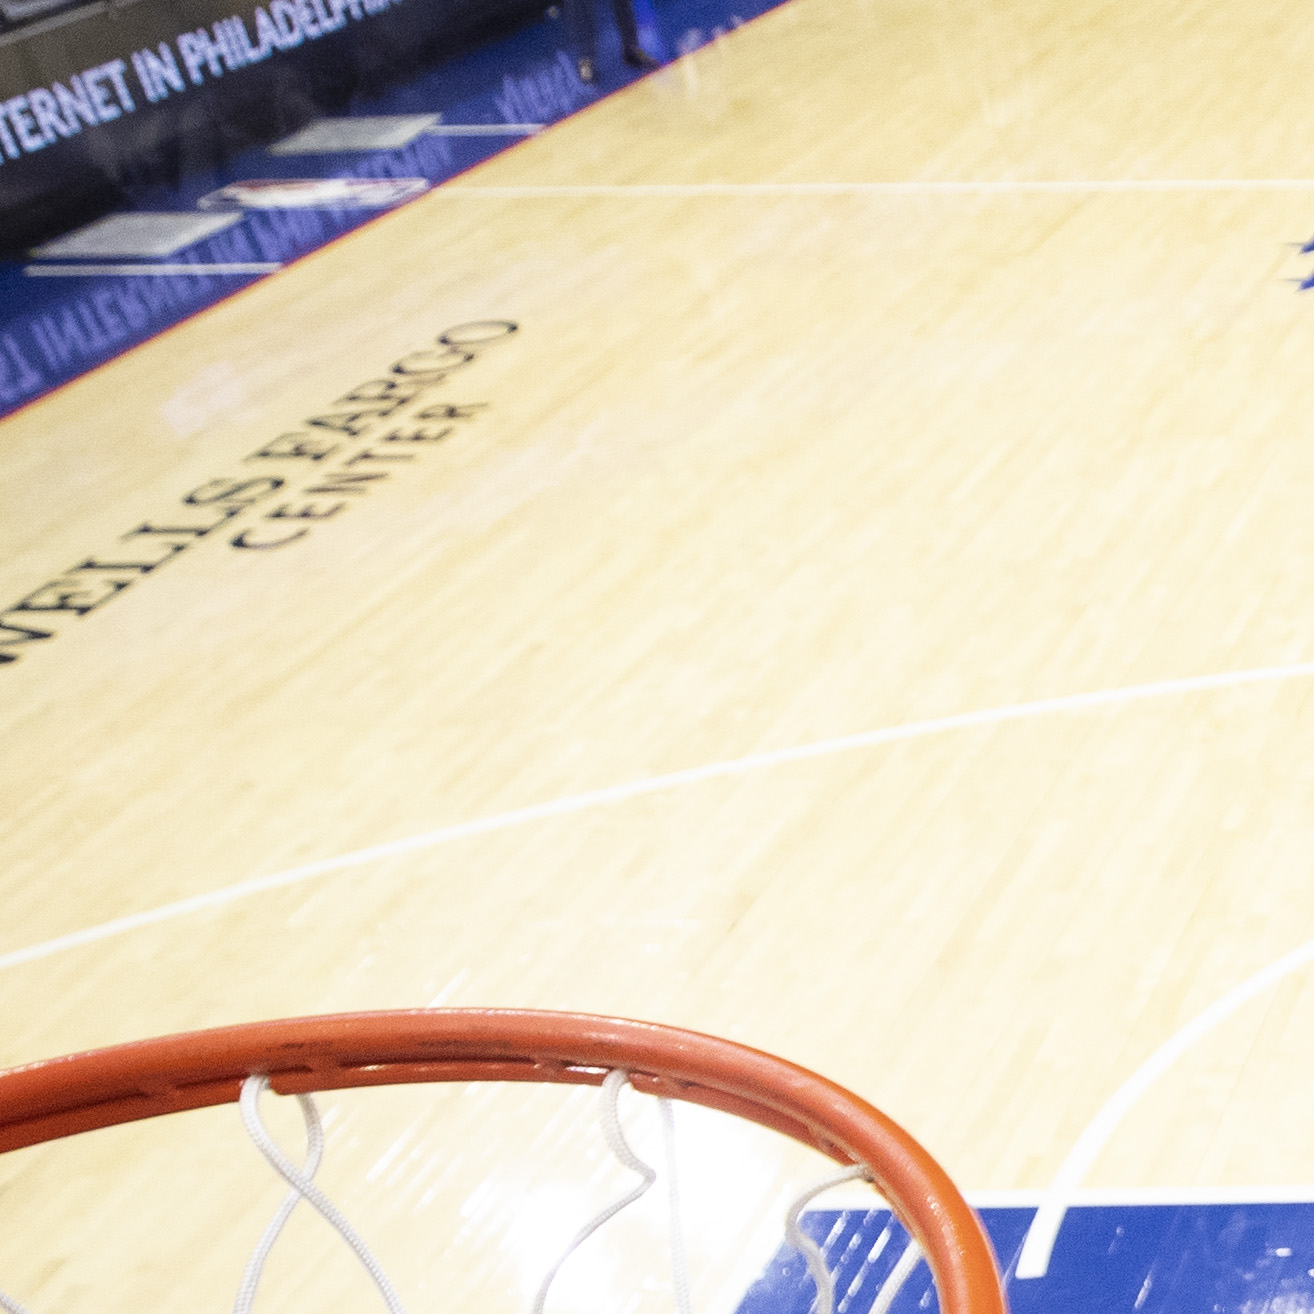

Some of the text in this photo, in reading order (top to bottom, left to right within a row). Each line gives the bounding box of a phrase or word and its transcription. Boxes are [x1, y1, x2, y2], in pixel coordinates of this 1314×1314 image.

[0, 57, 137, 166] TERNET
[130, 40, 187, 103] IN
[243, 320, 519, 463] FARGO
[230, 402, 490, 551] CENTER
